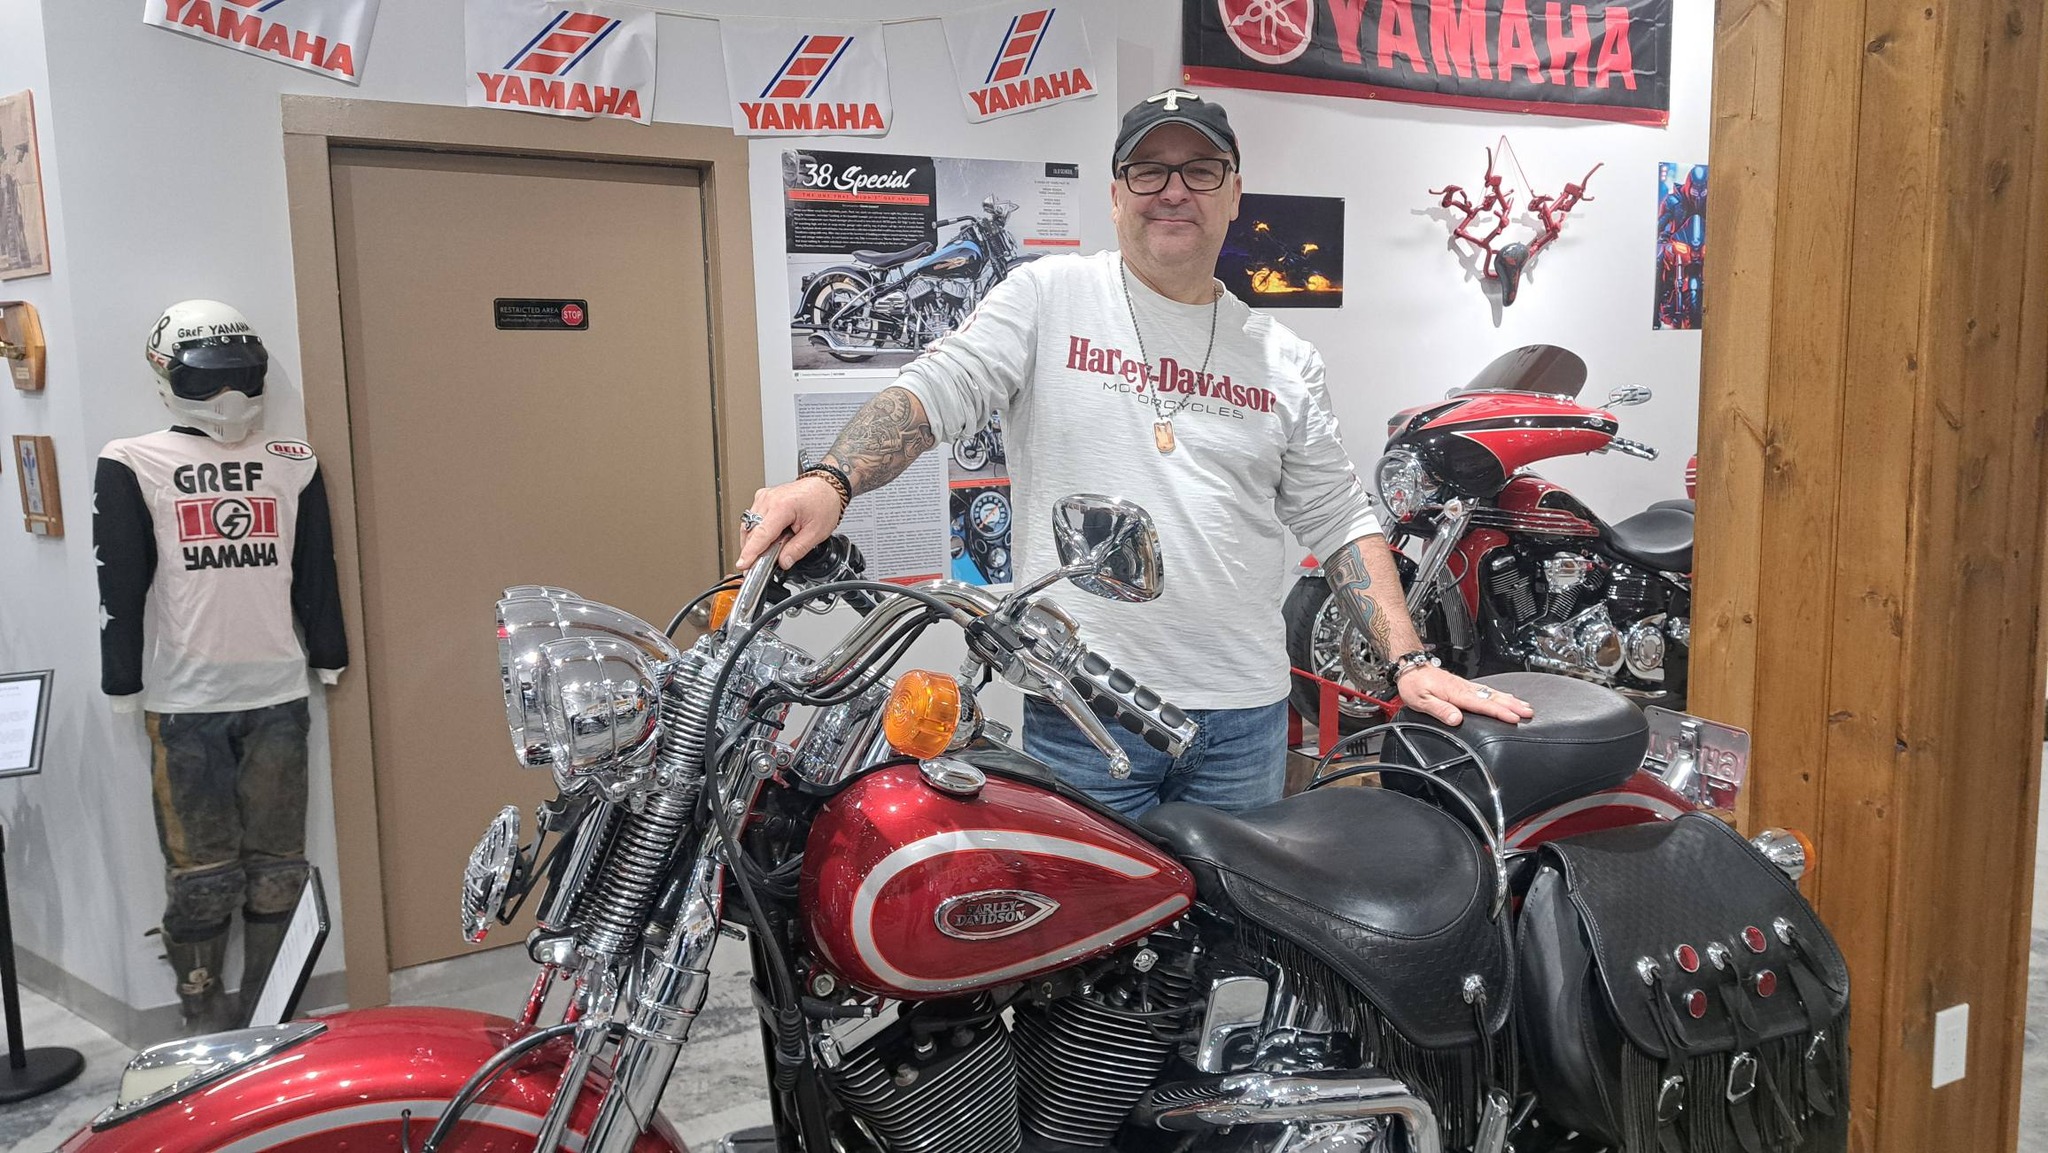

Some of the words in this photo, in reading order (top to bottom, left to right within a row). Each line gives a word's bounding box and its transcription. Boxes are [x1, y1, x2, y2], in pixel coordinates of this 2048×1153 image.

[165, 0, 354, 77] YAMAHA
[1329, 0, 1638, 90] YAMAHA
[476, 72, 642, 119] YAMAHA
[968, 67, 1093, 116] YAMAHA
[738, 102, 885, 130] YAMAHA
[802, 163, 833, 188] 38
[833, 167, 917, 196] Special
[500, 306, 541, 314] RESTRICTED
[563, 310, 581, 319] STOP
[1066, 335, 1276, 412] Harey-Davidson
[1103, 382, 1244, 420] MOORCYCLES
[273, 444, 309, 454] BELL
[173, 462, 264, 494] GREF
[183, 543, 279, 571] YAMAHA
